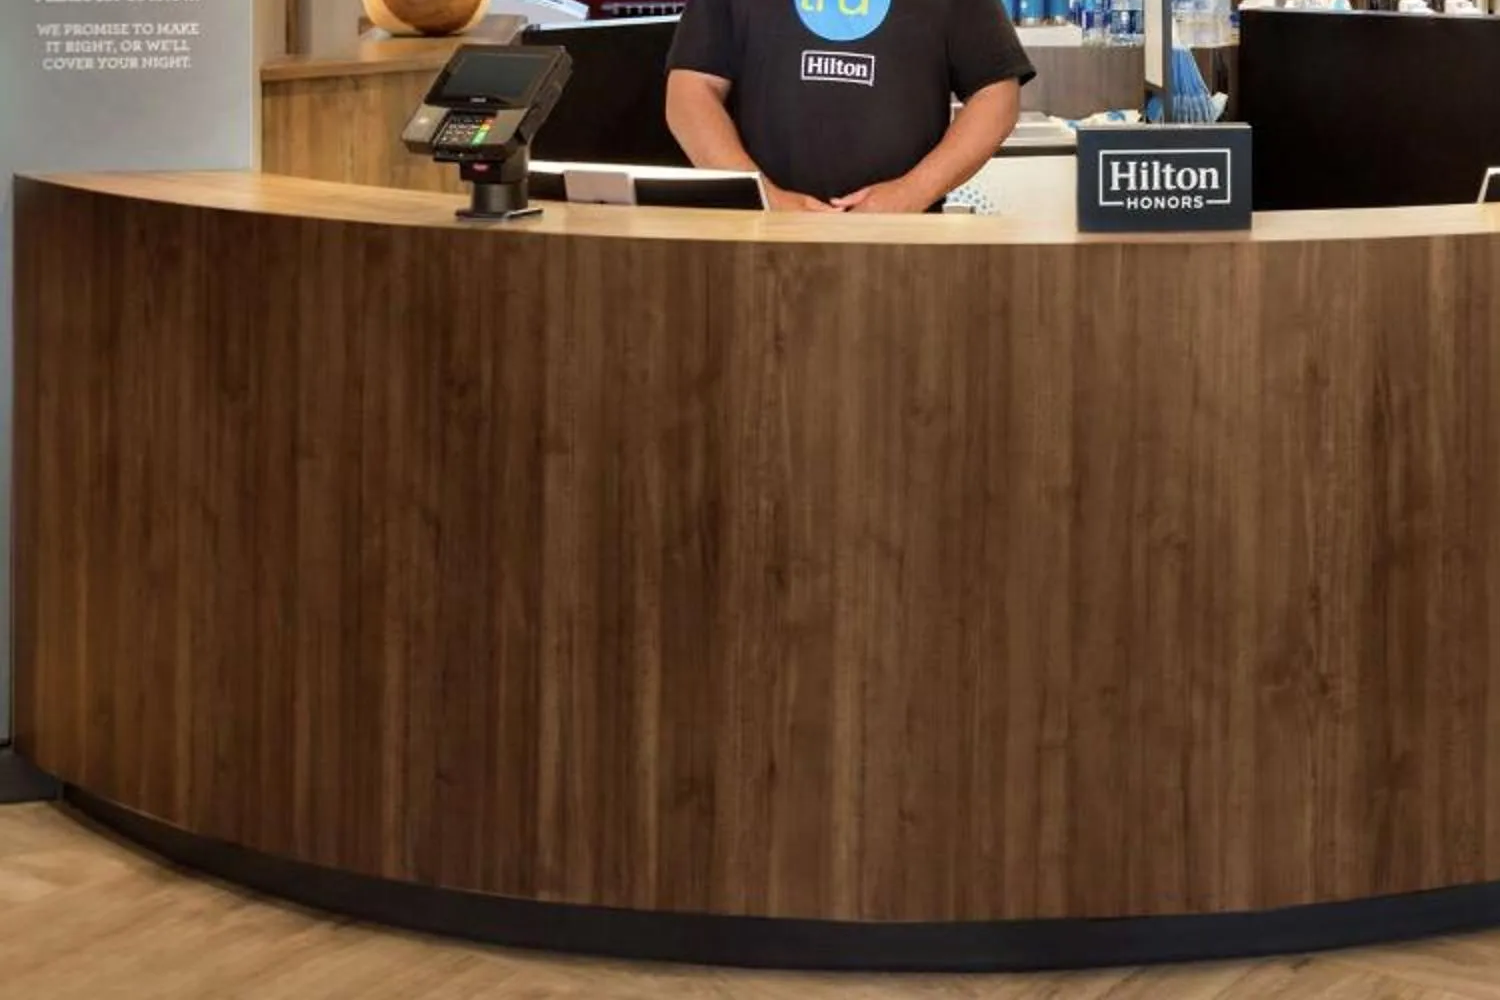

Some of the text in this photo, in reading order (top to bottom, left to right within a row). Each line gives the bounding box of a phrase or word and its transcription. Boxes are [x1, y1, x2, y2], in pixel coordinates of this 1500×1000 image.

[36, 23, 200, 36] WE PROMISE TO MAKE
[120, 40, 143, 52] OR
[42, 57, 94, 70] COVER
[97, 56, 140, 69] YOUR
[806, 55, 869, 78] Hilton
[1109, 160, 1221, 191] Hilton
[1126, 195, 1204, 210] HONORS
